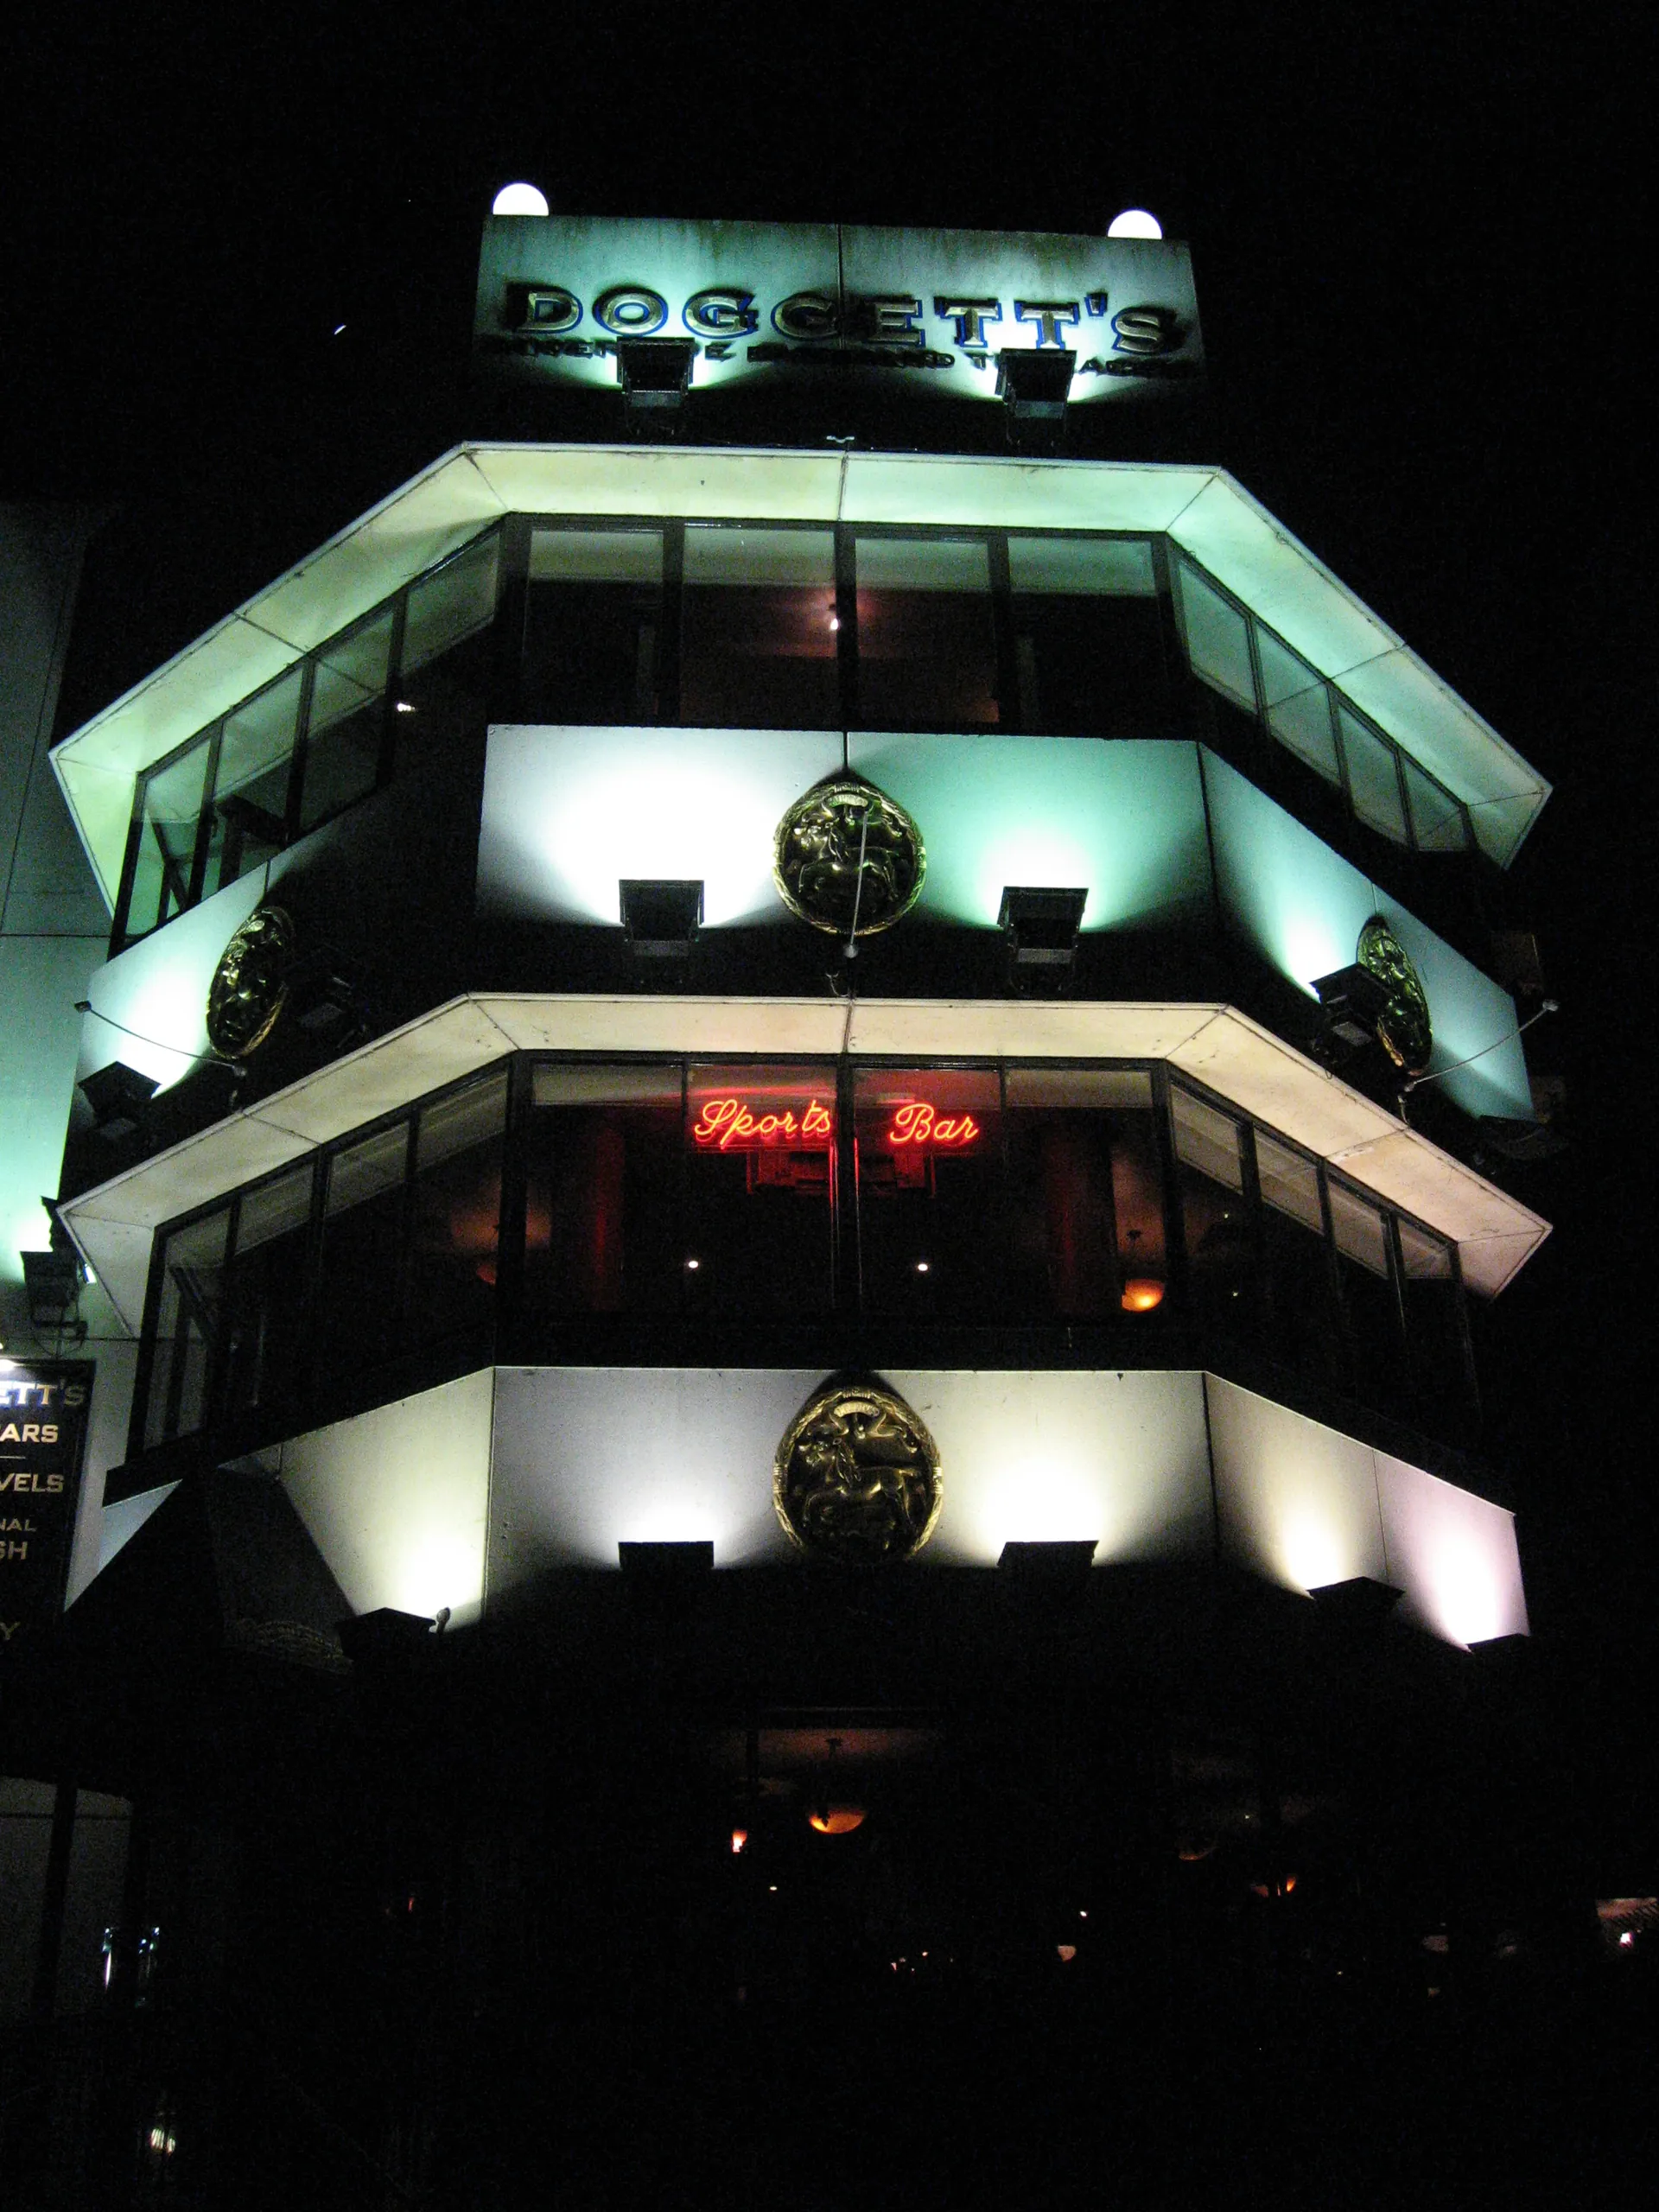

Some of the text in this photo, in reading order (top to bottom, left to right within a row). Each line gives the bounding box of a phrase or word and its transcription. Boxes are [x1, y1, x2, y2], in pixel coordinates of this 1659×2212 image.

[518, 285, 1180, 355] DOGGETT'S
[695, 1098, 980, 1148] Sports Bar
